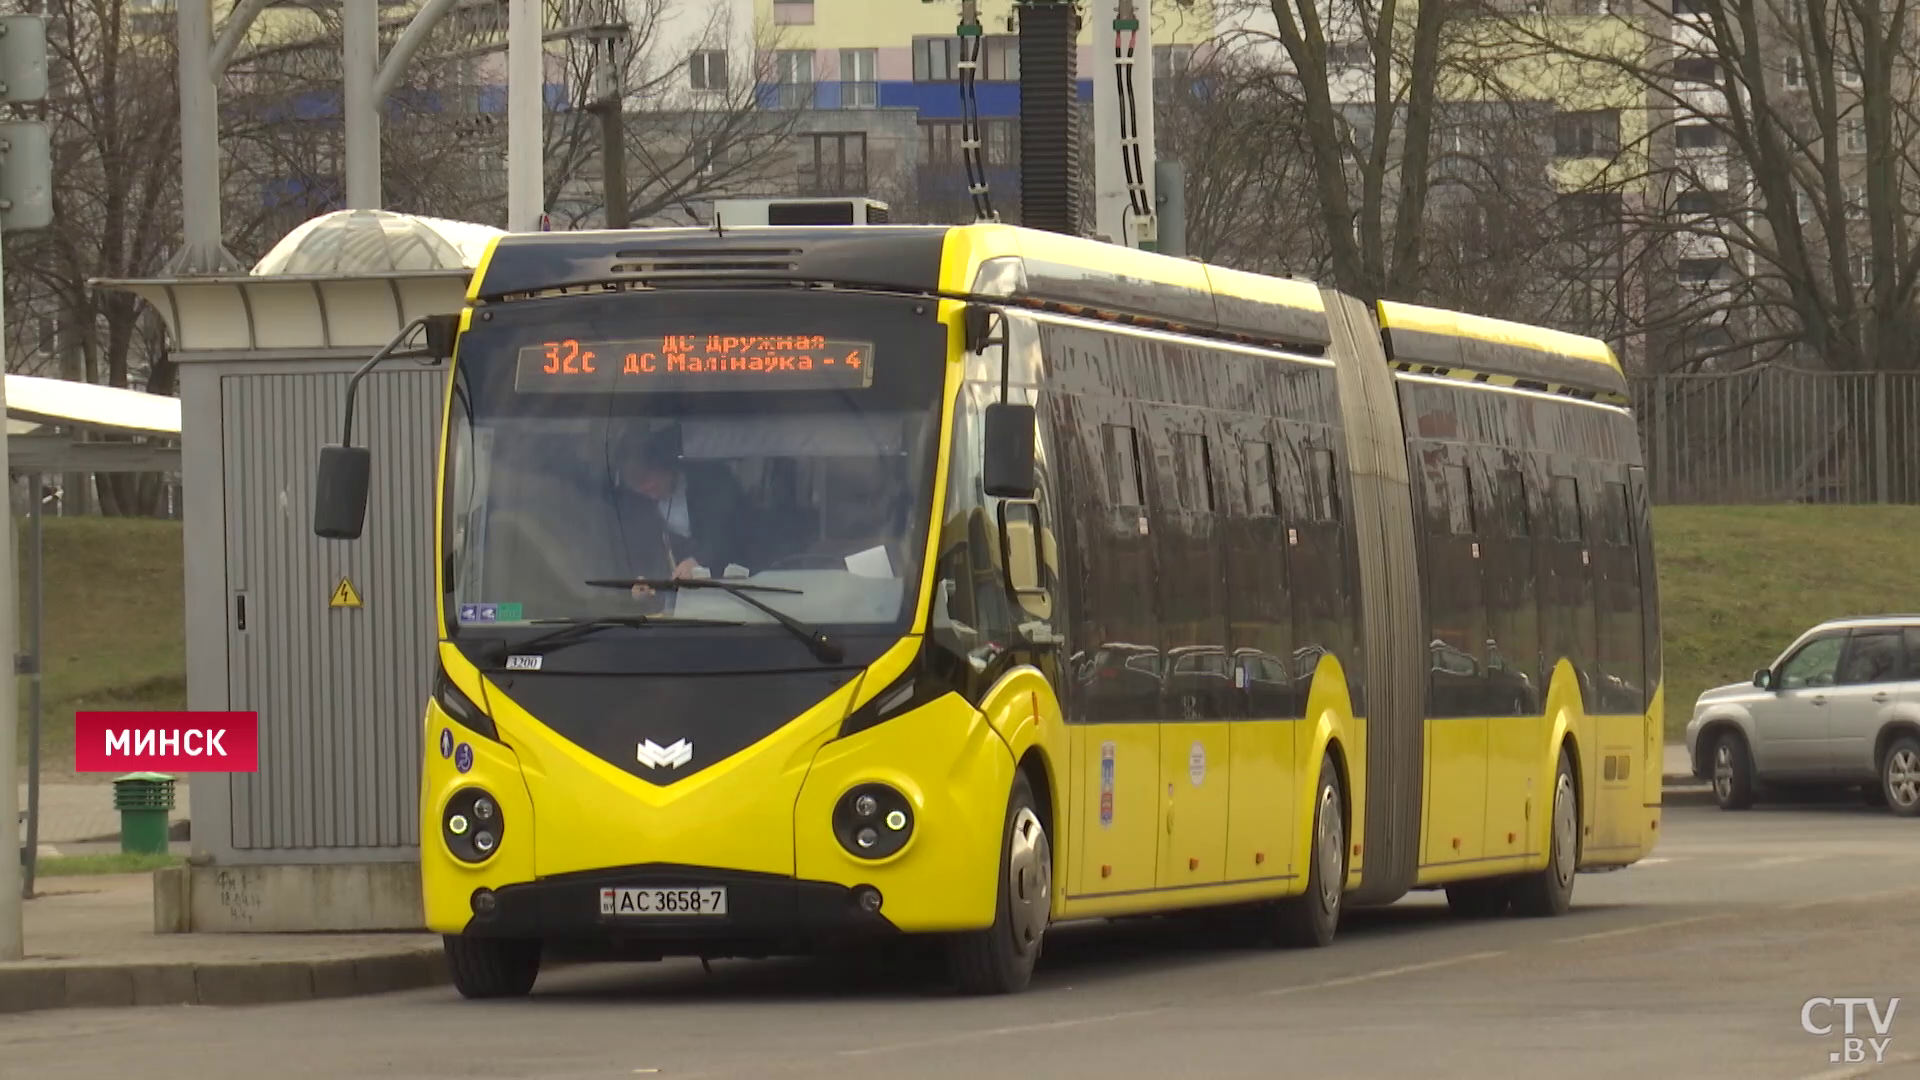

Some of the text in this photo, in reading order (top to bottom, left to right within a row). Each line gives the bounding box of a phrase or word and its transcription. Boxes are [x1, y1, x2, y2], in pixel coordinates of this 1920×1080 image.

[662, 334, 825, 354] ДС Дружная
[623, 353, 656, 376] ДС
[667, 351, 813, 373] Малінаўка
[845, 350, 862, 369] 4
[620, 891, 722, 912] AC 3658-7
